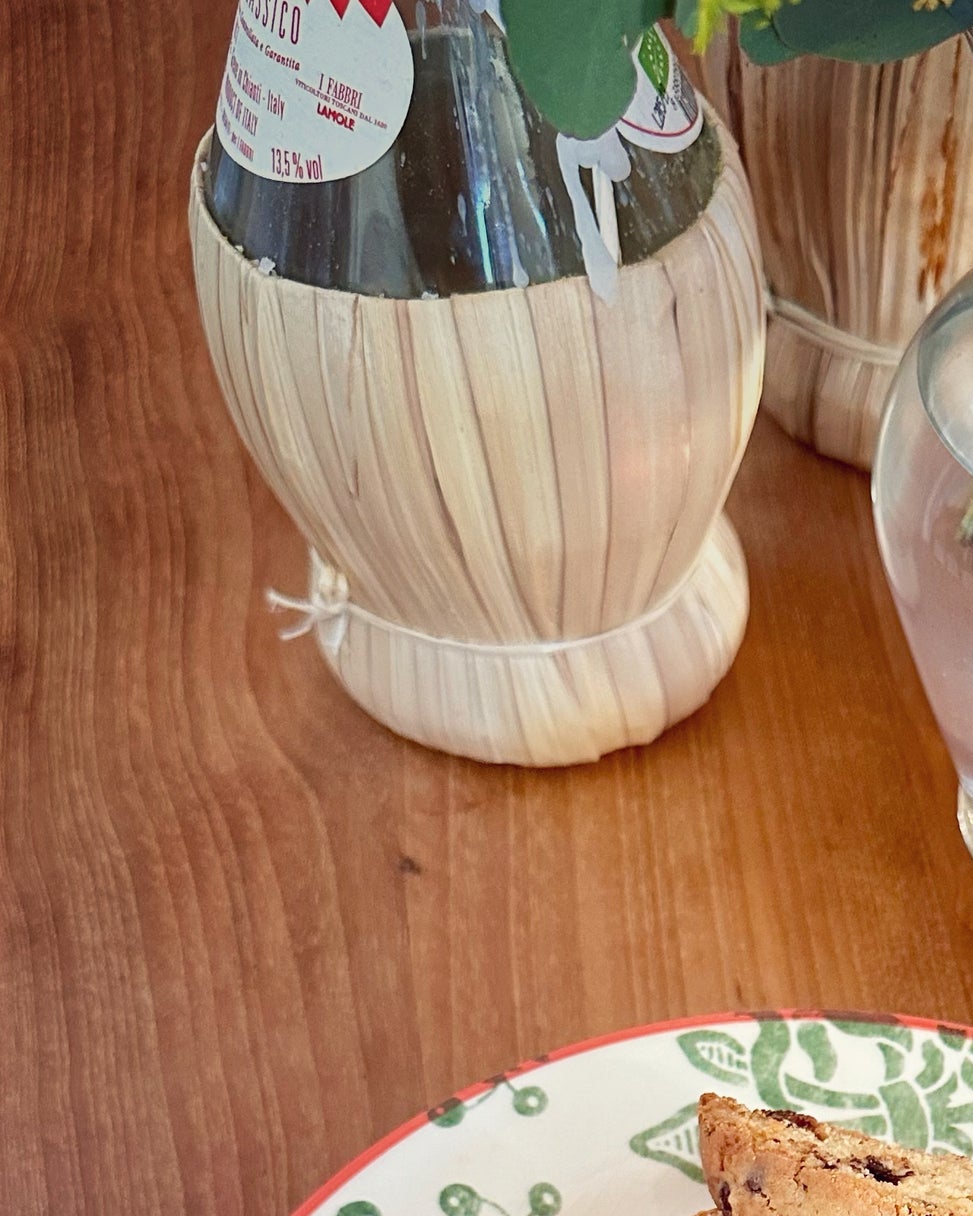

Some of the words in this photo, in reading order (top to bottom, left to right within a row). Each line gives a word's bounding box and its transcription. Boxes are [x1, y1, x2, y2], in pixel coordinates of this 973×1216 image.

[264, 45, 300, 71] Garantita
[266, 89, 285, 121] Italy
[318, 73, 324, 90] I
[326, 77, 363, 109] FABBRI
[242, 106, 258, 136] ITALY
[316, 102, 356, 131] LAMOLE
[331, 98, 359, 117] TOSCANI
[359, 112, 373, 124] DAL
[305, 154, 323, 180] vol
